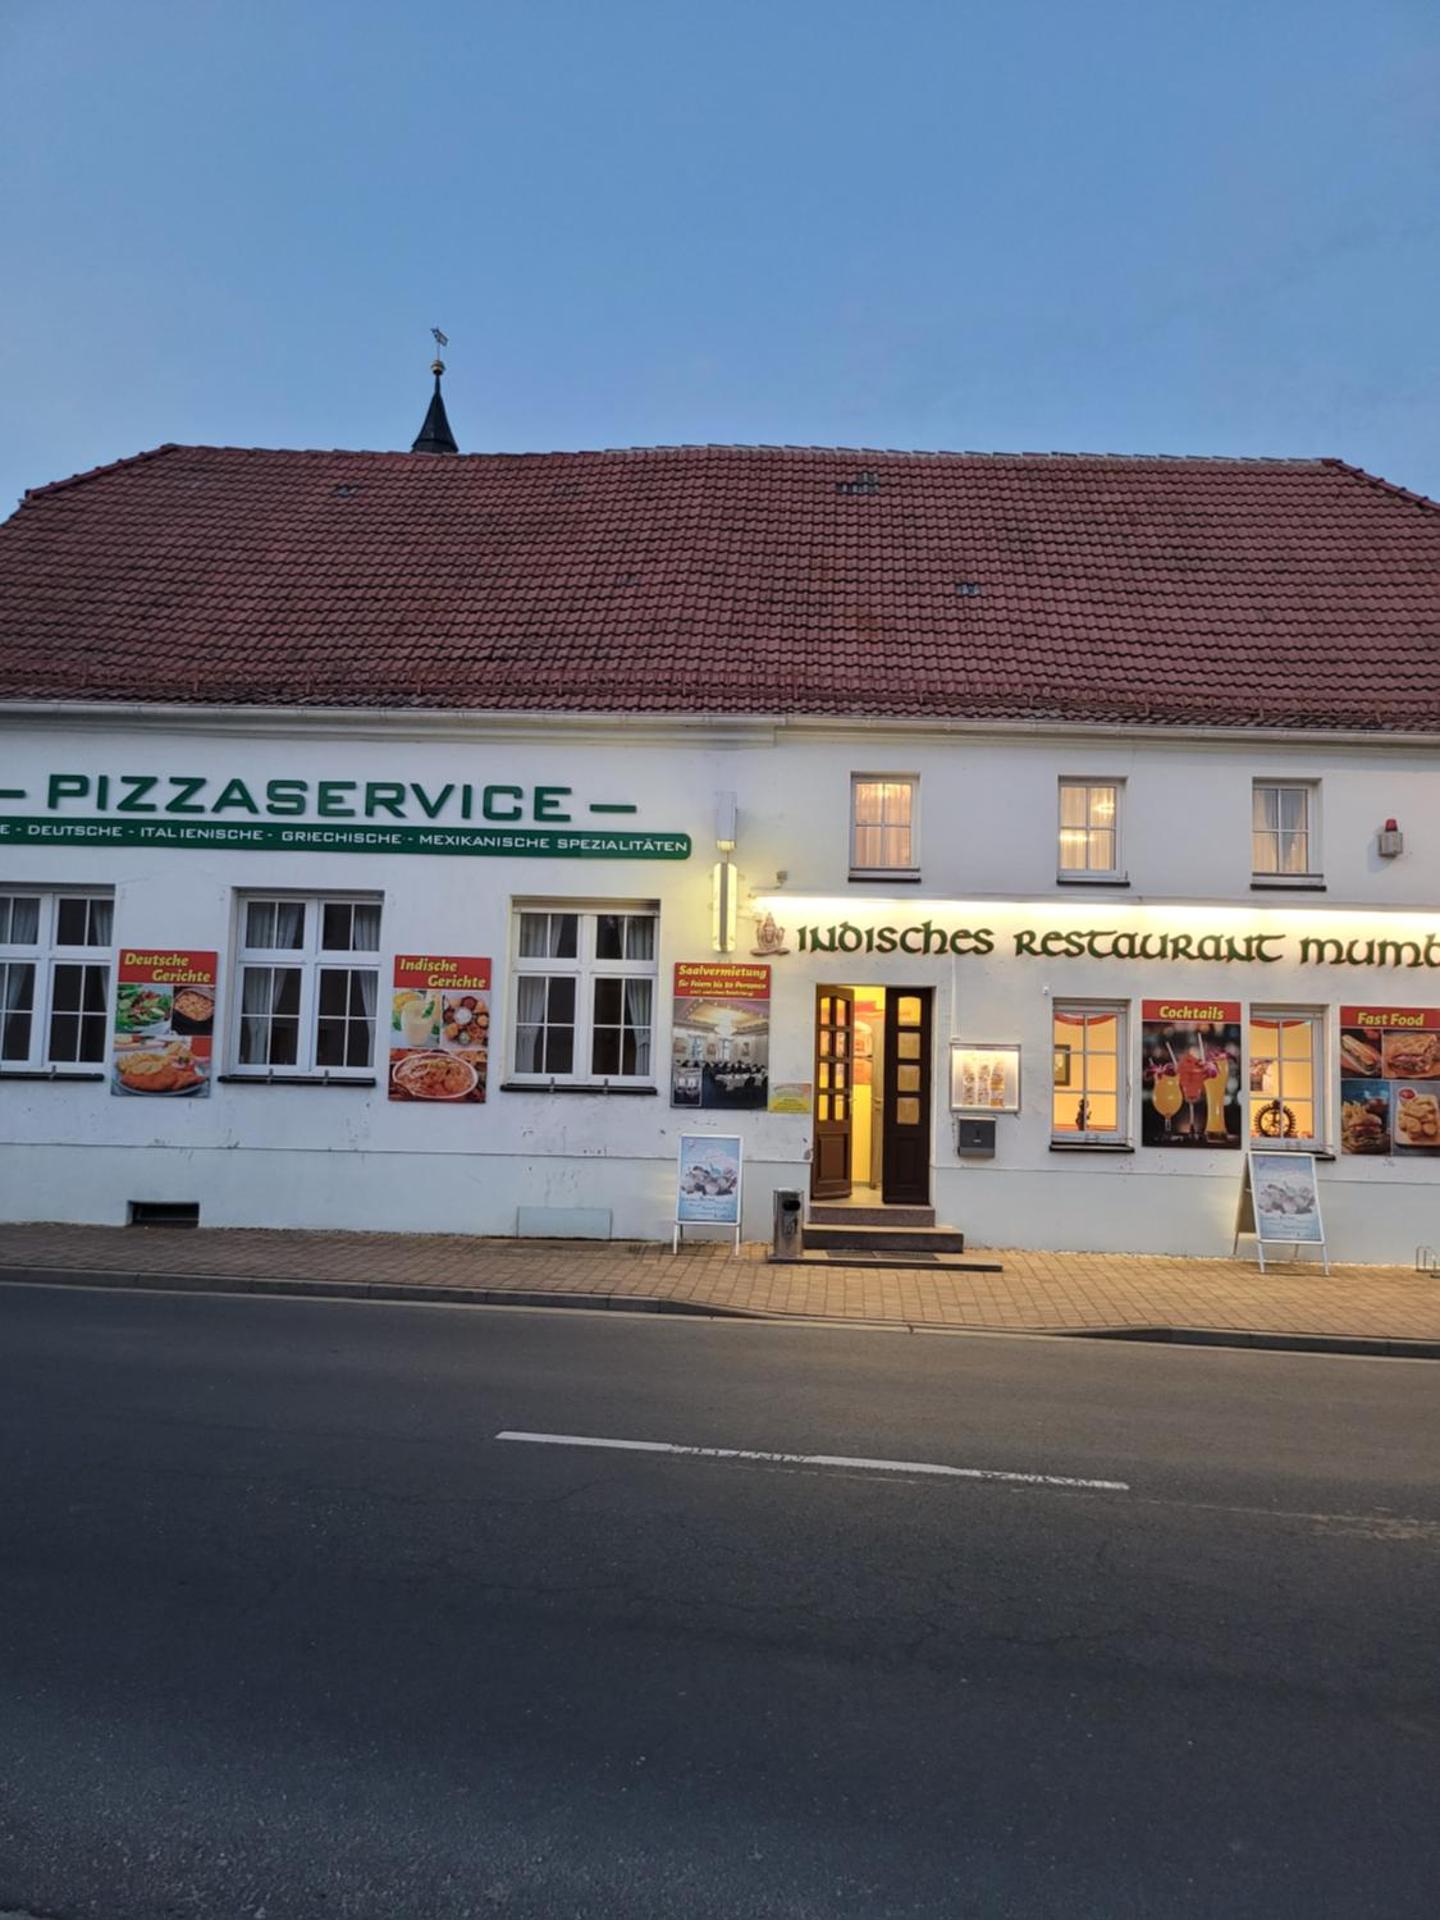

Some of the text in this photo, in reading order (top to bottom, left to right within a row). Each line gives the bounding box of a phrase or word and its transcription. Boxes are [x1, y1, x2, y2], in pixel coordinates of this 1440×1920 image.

[47, 774, 572, 822] PIZZASERVICE
[27, 824, 688, 851] DEUTSCHE ITALIENISCHE GRIECHISCHE MEXIKANISCHE SPEZIALITÄTEN
[124, 953, 189, 966] Deutsche
[400, 958, 457, 972] Indische
[152, 969, 211, 983] Gerichte
[678, 965, 767, 980] Saalvermietung
[427, 974, 486, 988] Gerichte
[1159, 1005, 1224, 1020] Cocktails
[1357, 1012, 1425, 1026] Fast Food
